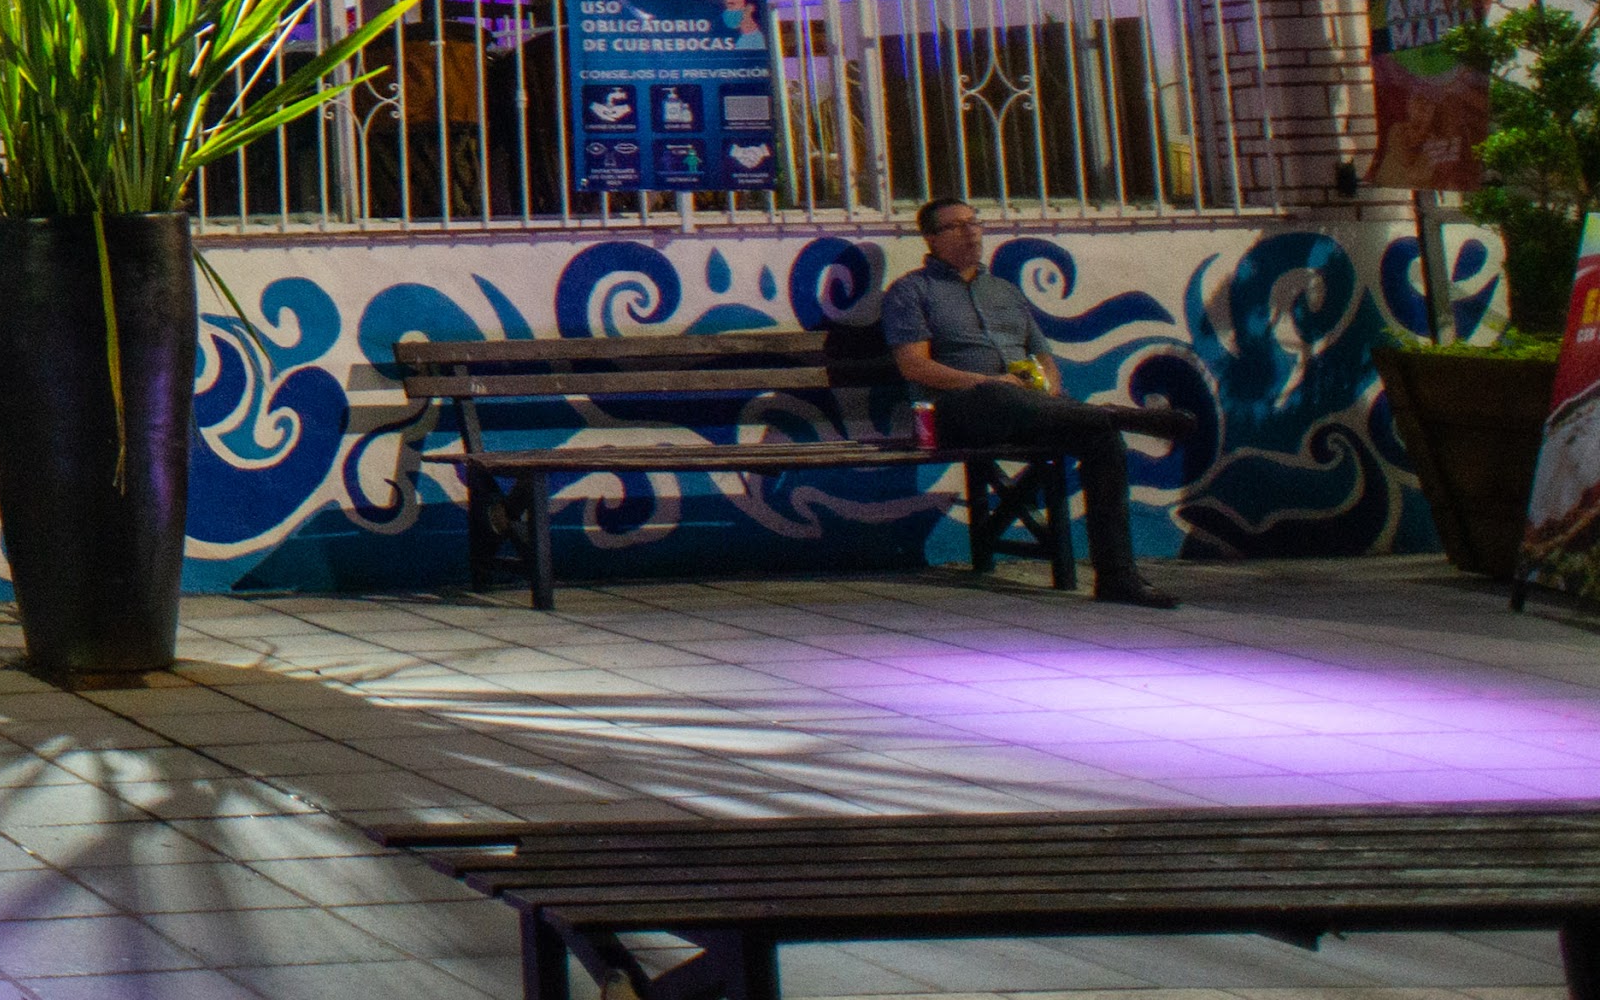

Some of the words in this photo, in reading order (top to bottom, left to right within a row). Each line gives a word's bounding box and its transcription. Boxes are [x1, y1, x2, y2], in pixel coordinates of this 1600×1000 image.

[580, 0, 622, 14] USO
[581, 19, 711, 33] OBLIGATORIO
[583, 38, 607, 51] DE
[612, 37, 735, 51] CUBREBOCAS
[580, 69, 655, 79] CONSEJOS
[658, 69, 680, 79] DE
